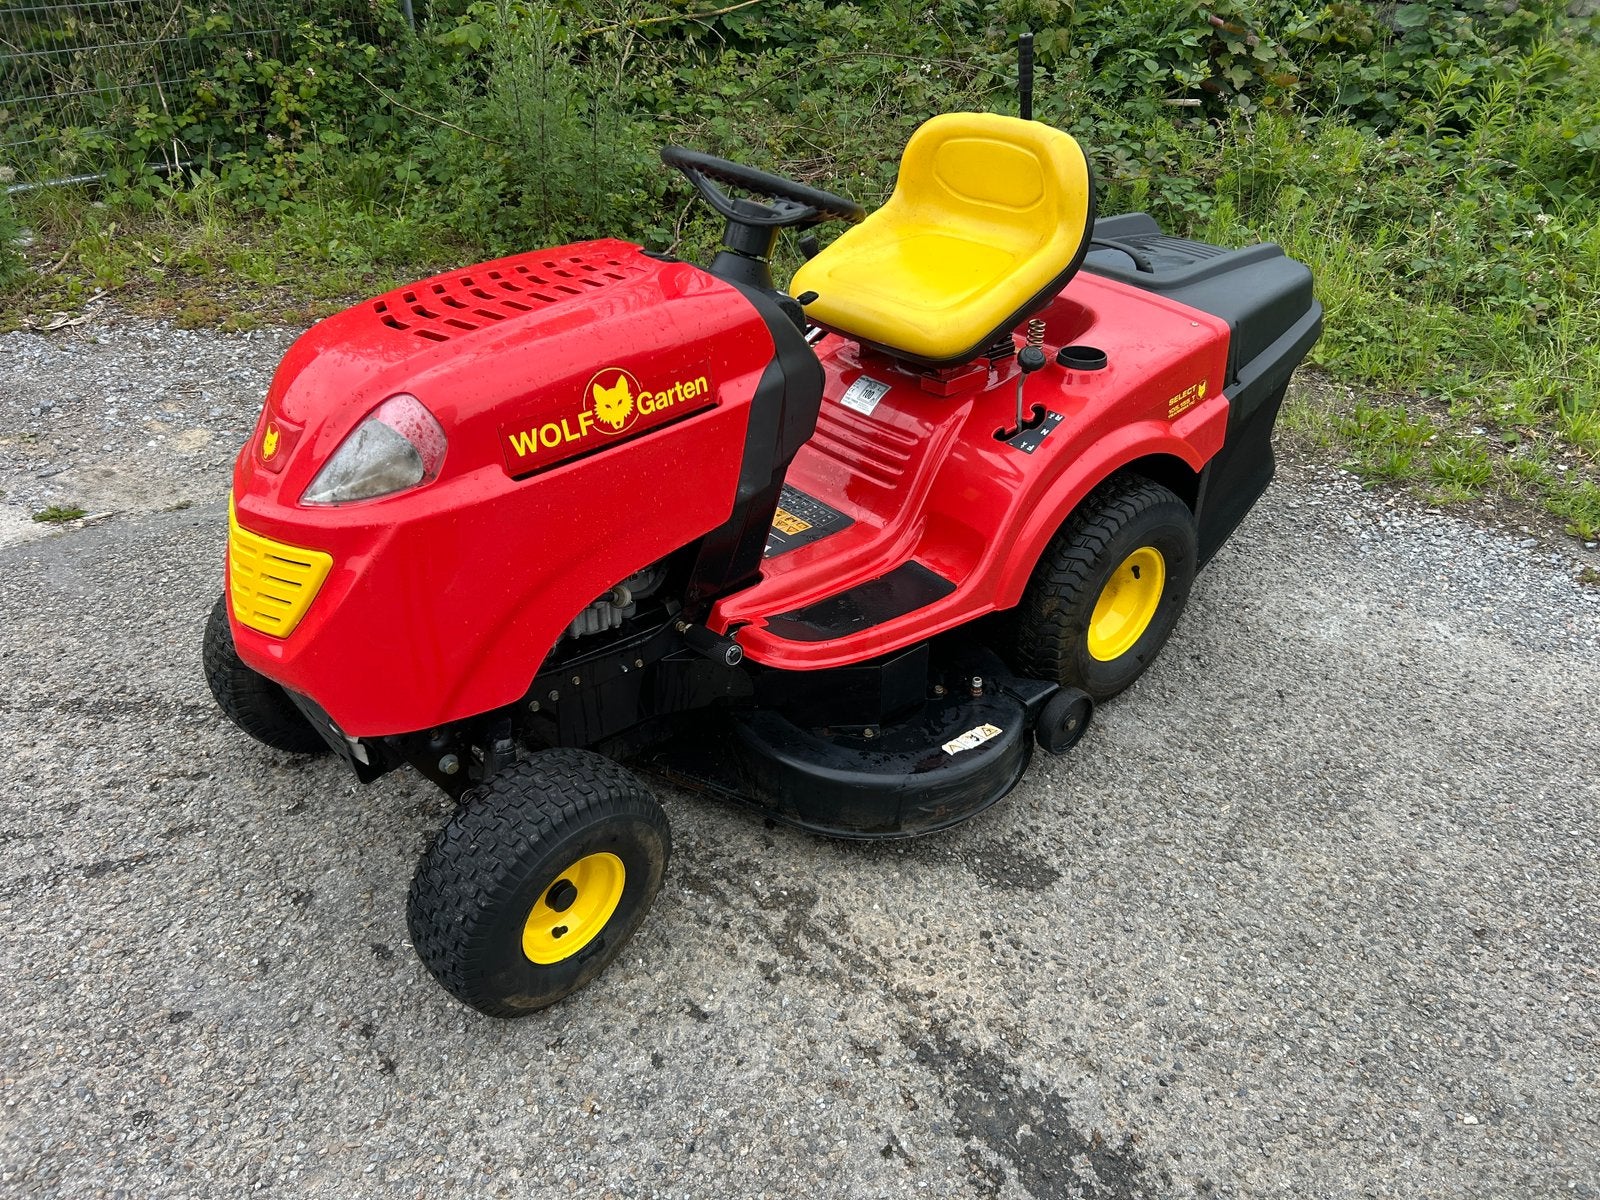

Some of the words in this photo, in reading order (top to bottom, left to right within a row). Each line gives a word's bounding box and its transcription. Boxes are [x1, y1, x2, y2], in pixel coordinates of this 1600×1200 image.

[1168, 384, 1197, 406] SELECT
[509, 410, 595, 457] WOLF
[636, 376, 708, 415] Garten
[1040, 428, 1050, 436] N
